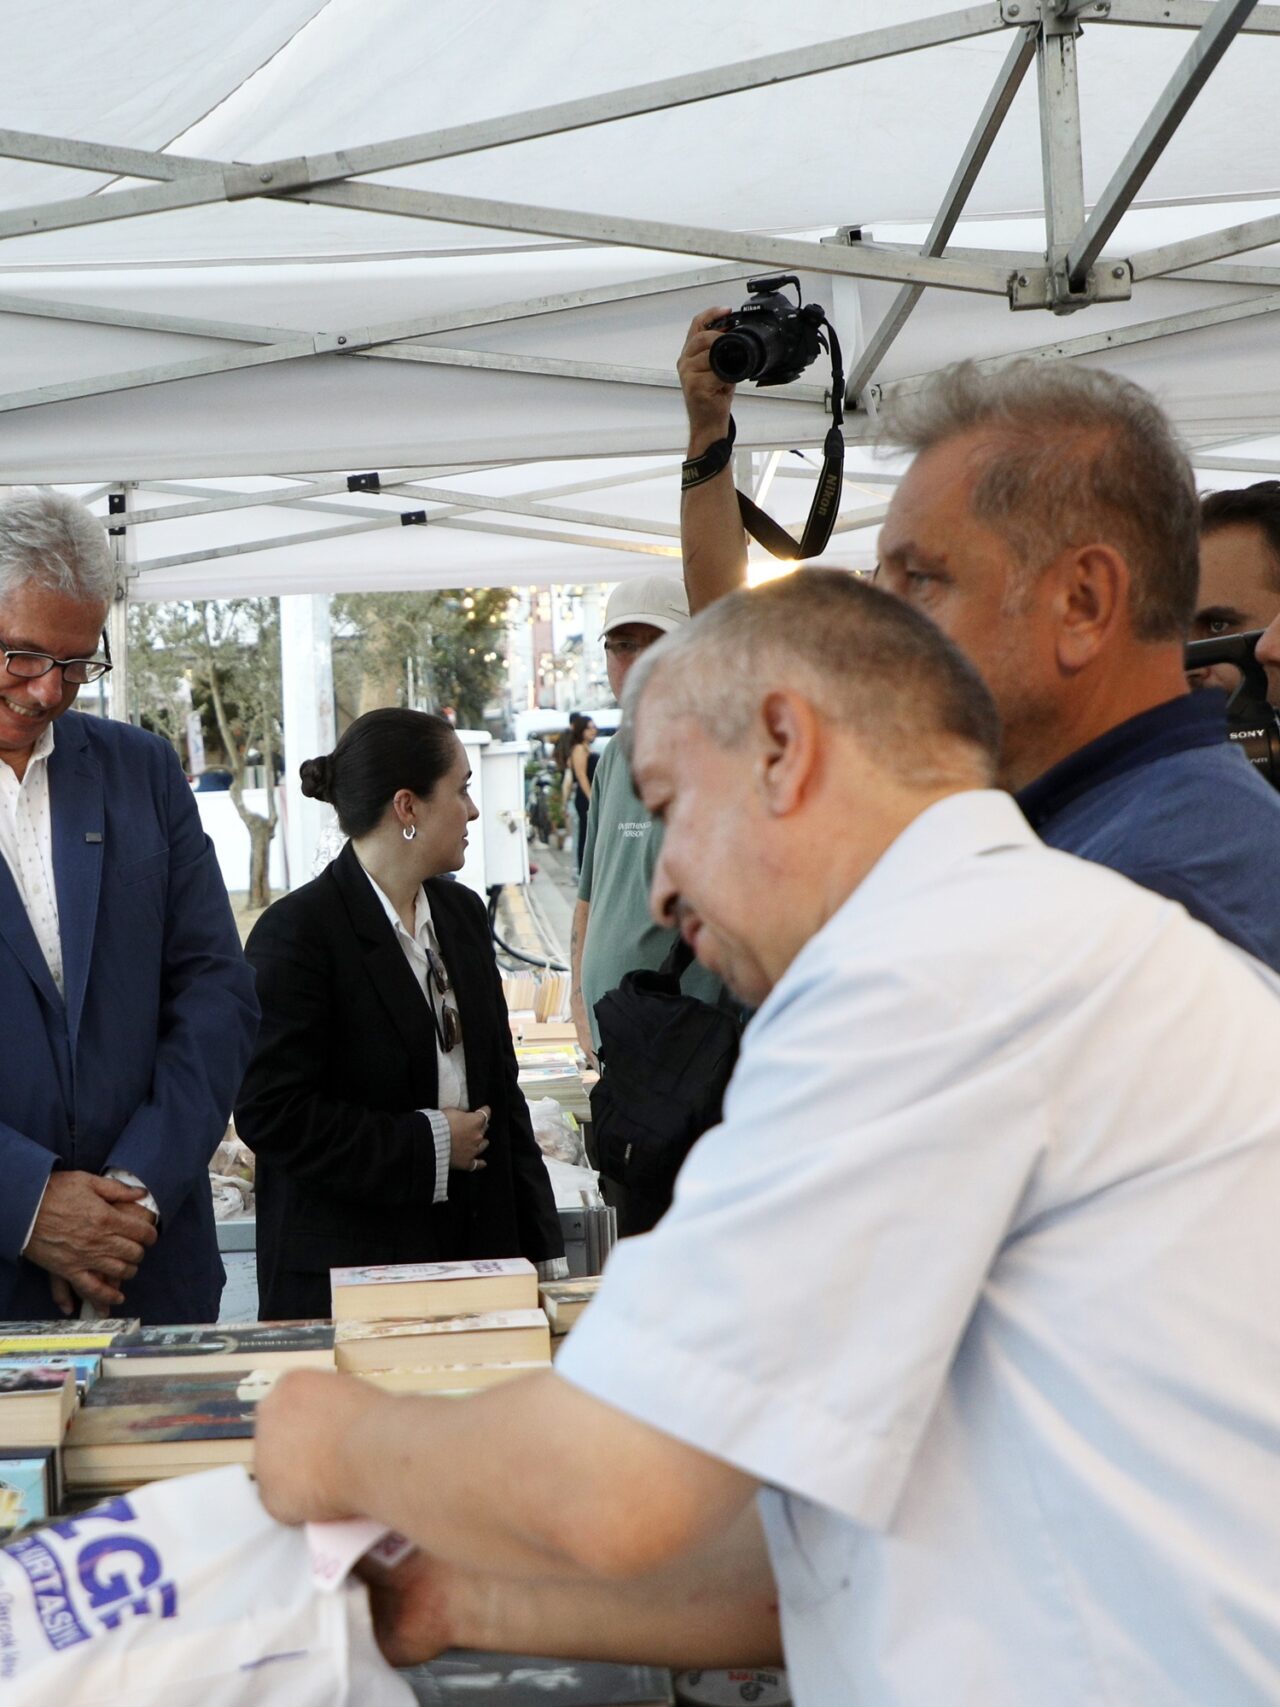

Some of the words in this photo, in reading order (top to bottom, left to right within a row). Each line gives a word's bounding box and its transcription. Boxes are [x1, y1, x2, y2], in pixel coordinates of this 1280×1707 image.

[742, 304, 761, 312] Nikon
[818, 473, 838, 516] Nikon
[1229, 729, 1265, 739] SONY
